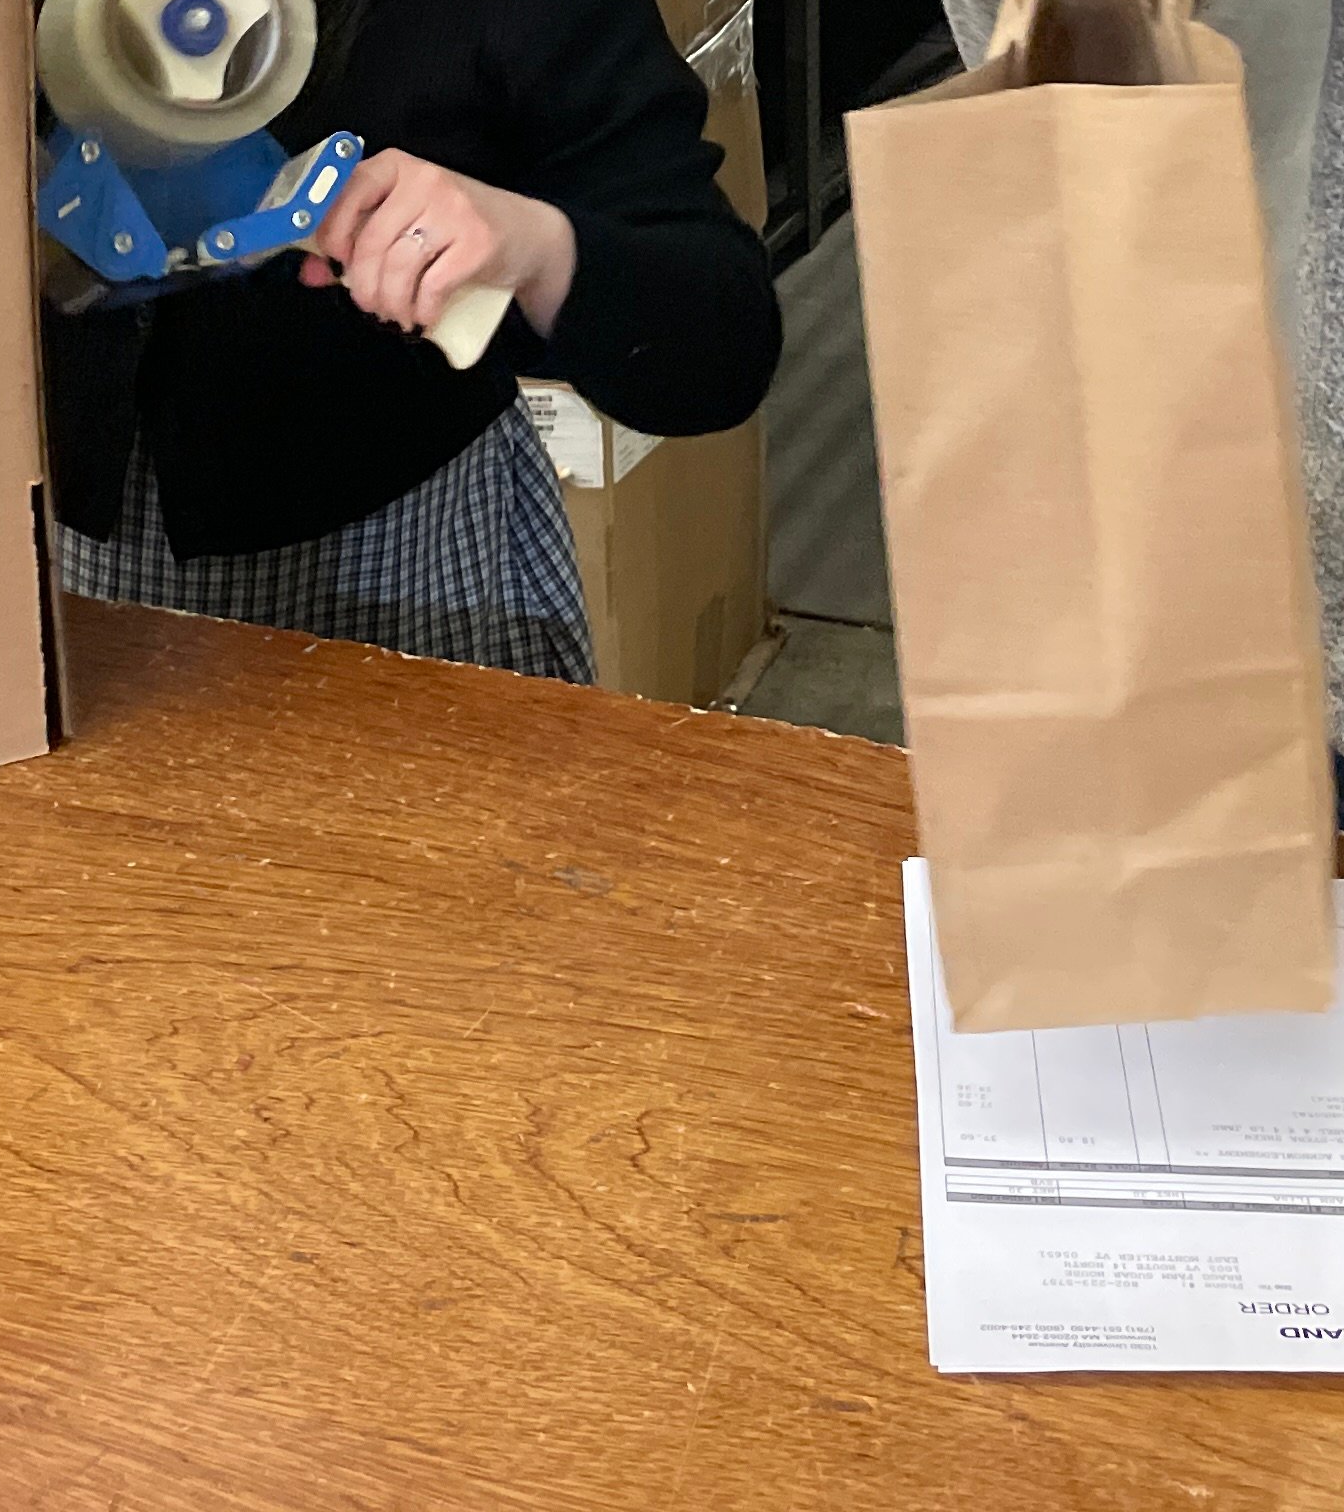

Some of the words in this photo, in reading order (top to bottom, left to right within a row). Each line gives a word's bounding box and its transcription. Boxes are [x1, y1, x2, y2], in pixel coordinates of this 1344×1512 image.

[1095, 1252, 1111, 1260] VT
[1119, 1253, 1199, 1262] MONTPELIER
[1136, 1263, 1176, 1271] ROUTE
[1185, 1264, 1201, 1272] VT
[1113, 1272, 1154, 1280] SUGAR
[1238, 1300, 1330, 1316] ORDER
